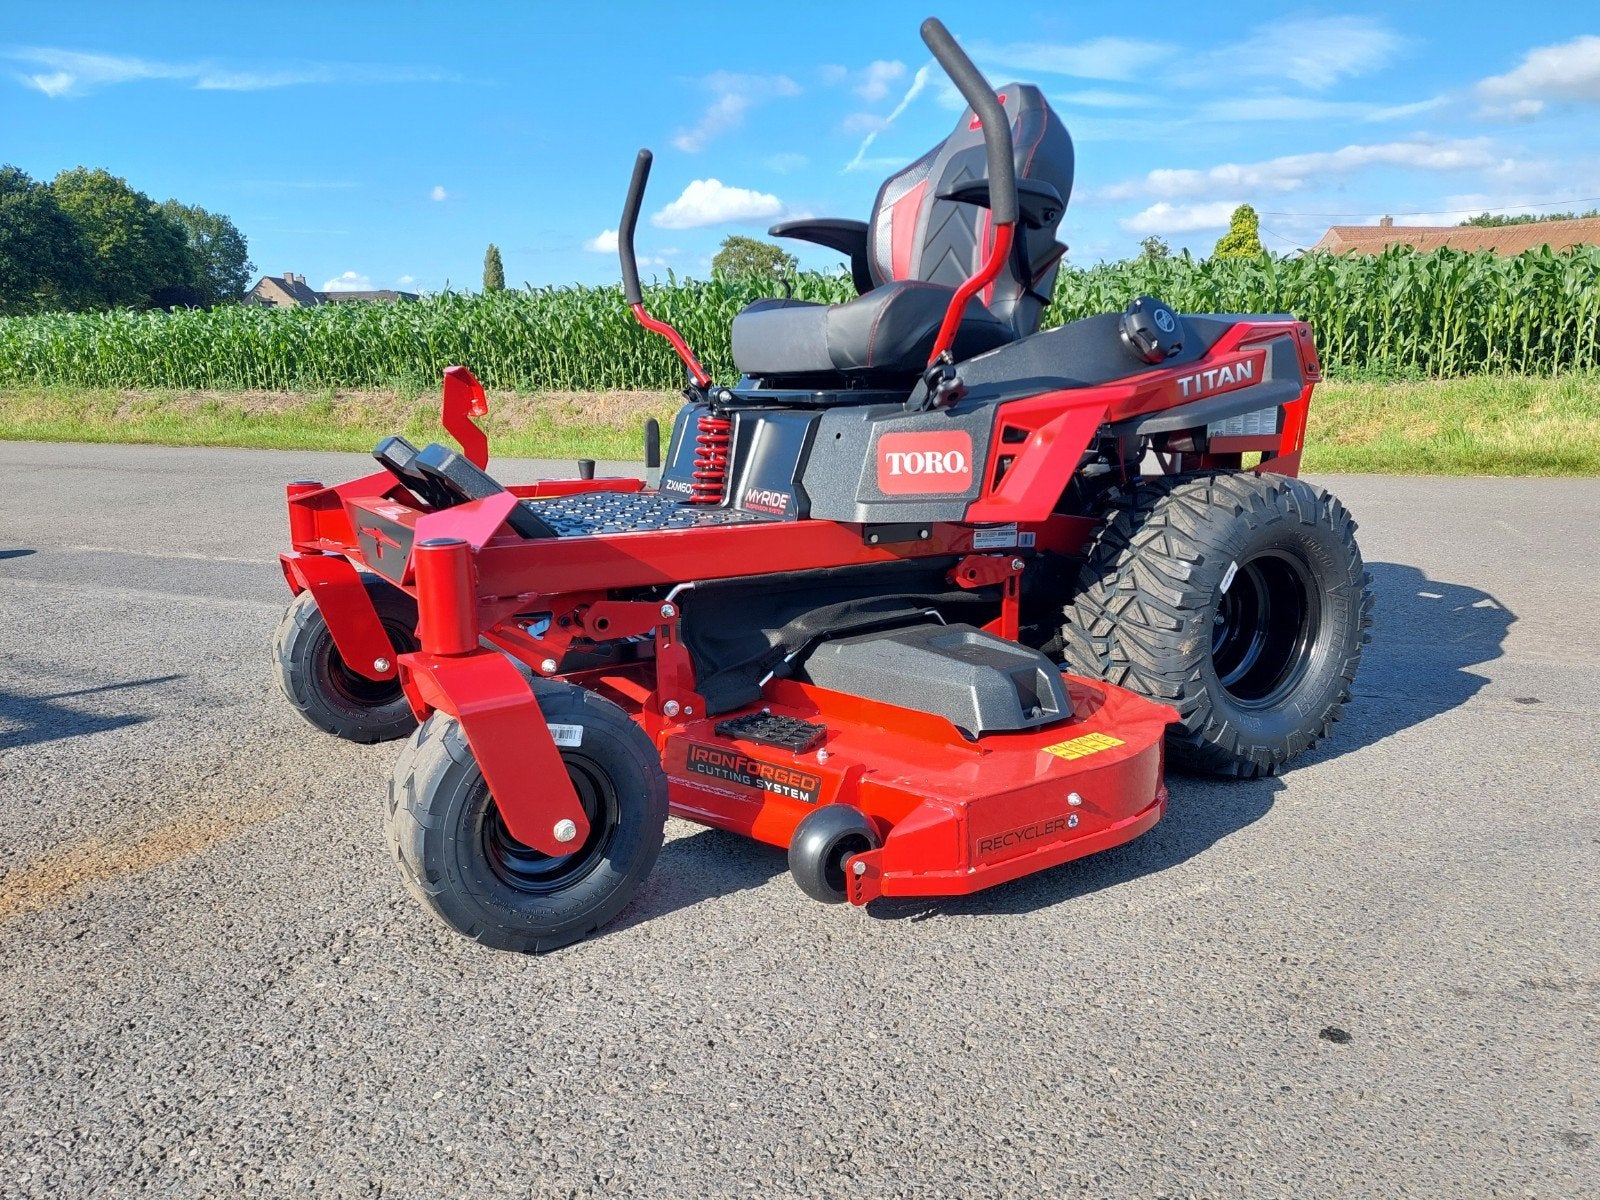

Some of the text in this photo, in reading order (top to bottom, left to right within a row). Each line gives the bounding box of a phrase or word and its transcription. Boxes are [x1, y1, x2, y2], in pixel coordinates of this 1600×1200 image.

[1177, 360, 1253, 397] TITAN
[697, 763, 809, 802] CUTTING SYSTEM
[980, 818, 1066, 853] RECYCLER
